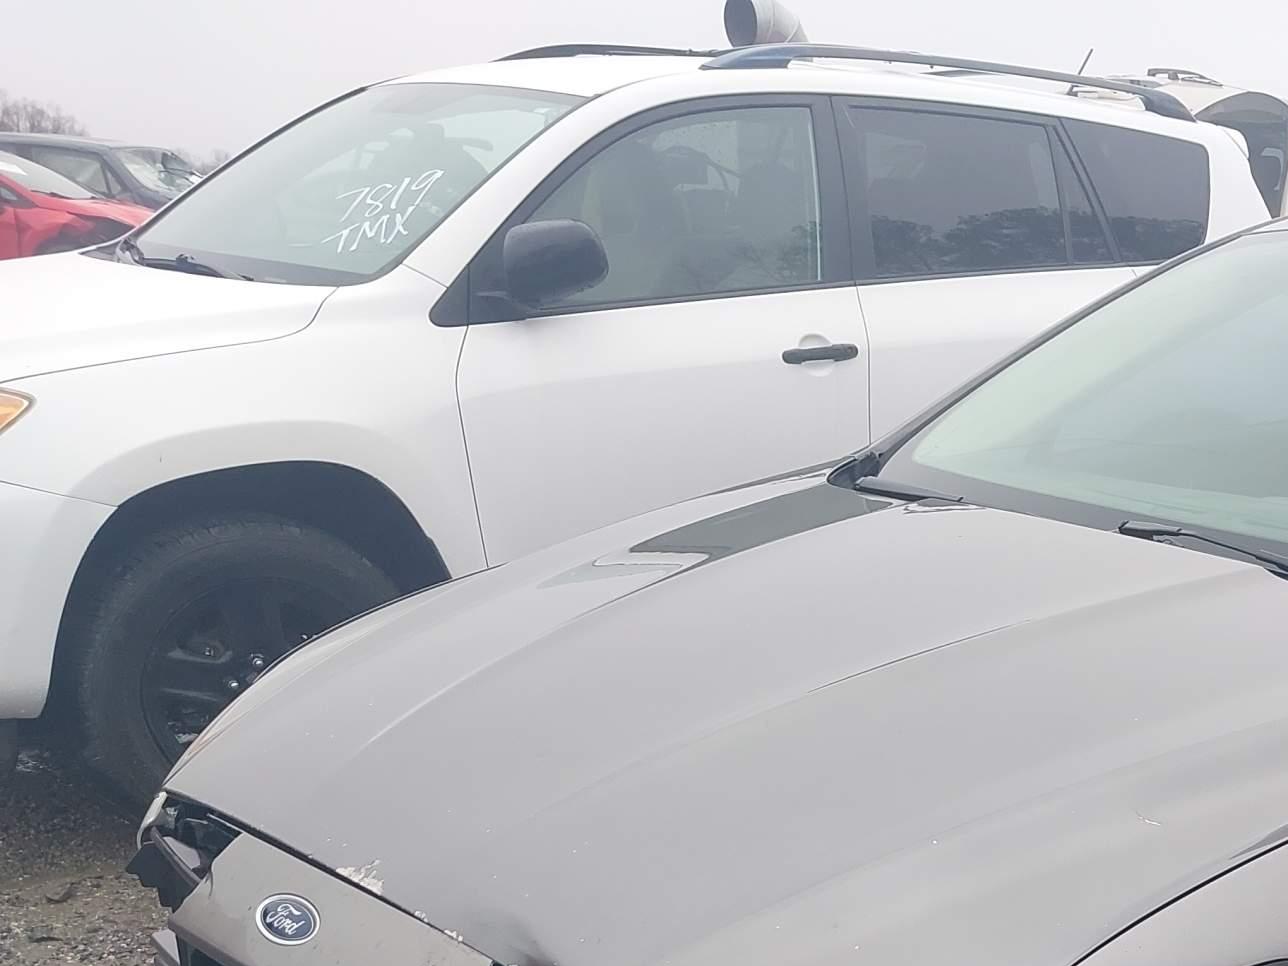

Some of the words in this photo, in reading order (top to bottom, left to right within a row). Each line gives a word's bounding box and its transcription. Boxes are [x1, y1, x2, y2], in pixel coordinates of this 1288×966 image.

[335, 168, 445, 222] 7819
[320, 205, 416, 254] TMX
[265, 903, 306, 935] Ford
